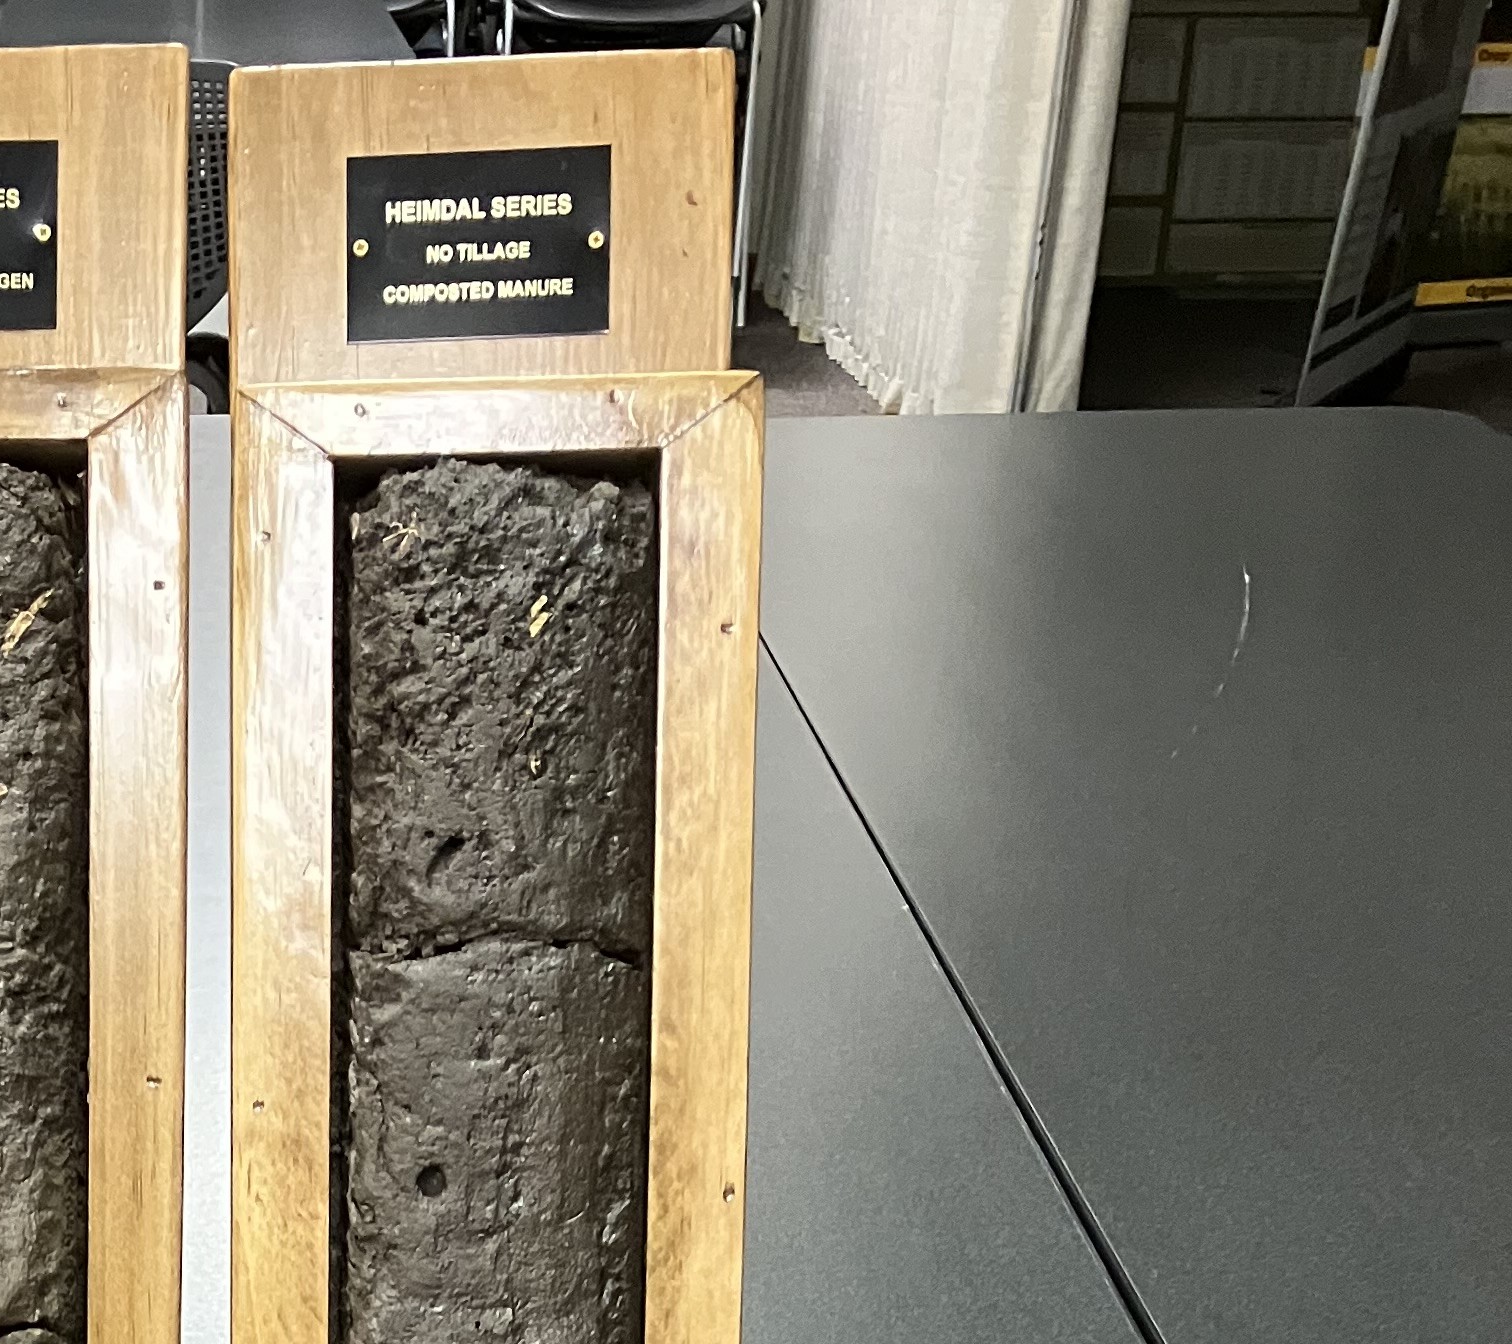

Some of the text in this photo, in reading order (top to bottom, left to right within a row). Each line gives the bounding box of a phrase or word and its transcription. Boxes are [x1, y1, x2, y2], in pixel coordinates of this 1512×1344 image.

[385, 192, 573, 225] HEIMDAL SERIES
[425, 240, 531, 265] NO TILLAGE
[383, 277, 574, 306] COMPOSTED MANURE
